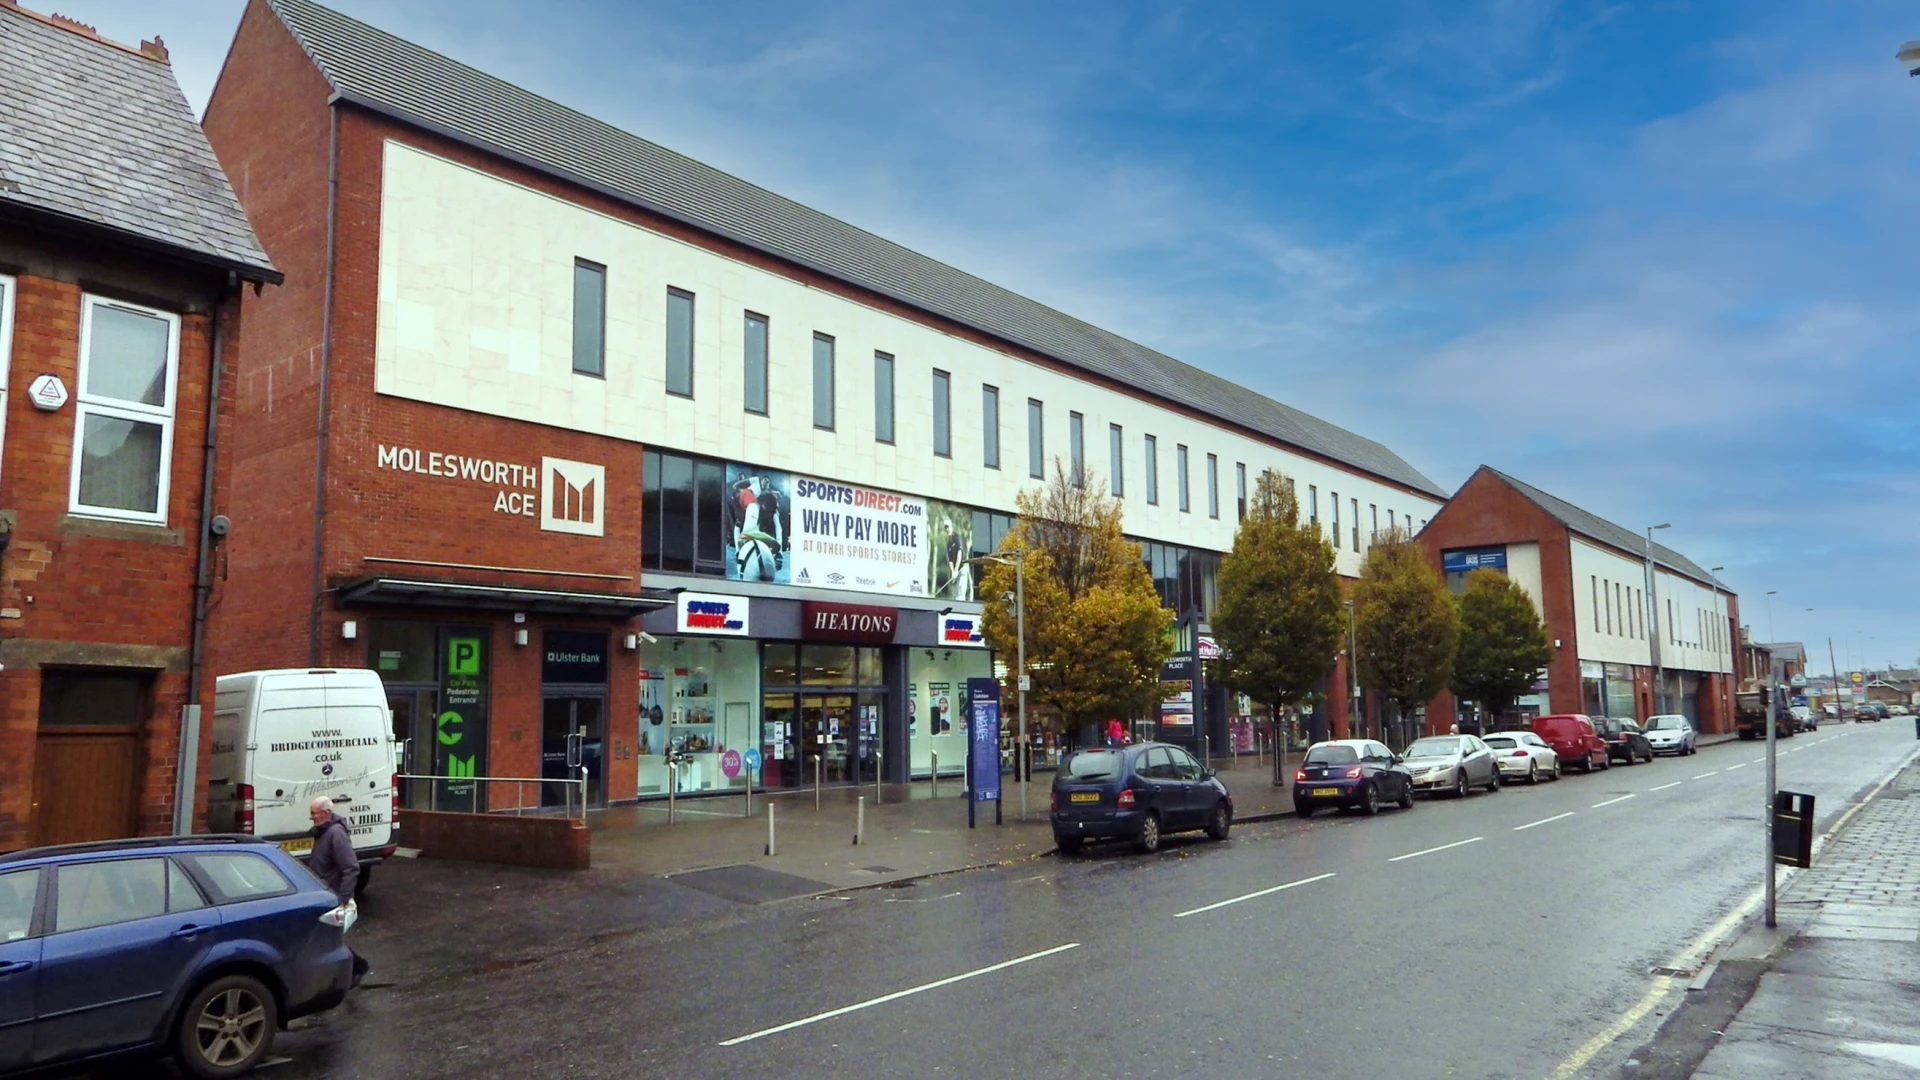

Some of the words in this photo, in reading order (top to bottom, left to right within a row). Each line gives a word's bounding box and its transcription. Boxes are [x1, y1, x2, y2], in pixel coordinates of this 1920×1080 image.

[377, 444, 536, 489] MOLESWORTH
[493, 491, 535, 517] ACE
[802, 508, 840, 537] WHY
[845, 515, 872, 541] PAY
[877, 520, 917, 548] MORE
[803, 540, 813, 552] AT
[816, 540, 844, 556] OTHER
[847, 545, 879, 561] SPORTS
[882, 550, 916, 565] STORES?
[856, 576, 876, 585] Reebok
[814, 612, 891, 632] HEATONS
[456, 643, 473, 670] P
[556, 653, 579, 662] Ulster
[581, 653, 600, 663] Bank
[449, 696, 476, 704] Entrance
[312, 729, 342, 738] www.
[271, 737, 378, 752] BRIDGECOMMERCIALS
[313, 751, 342, 762] .co.uk
[350, 804, 370, 813] SALES
[359, 813, 383, 824] HIRE
[349, 827, 373, 836] ERVICE
